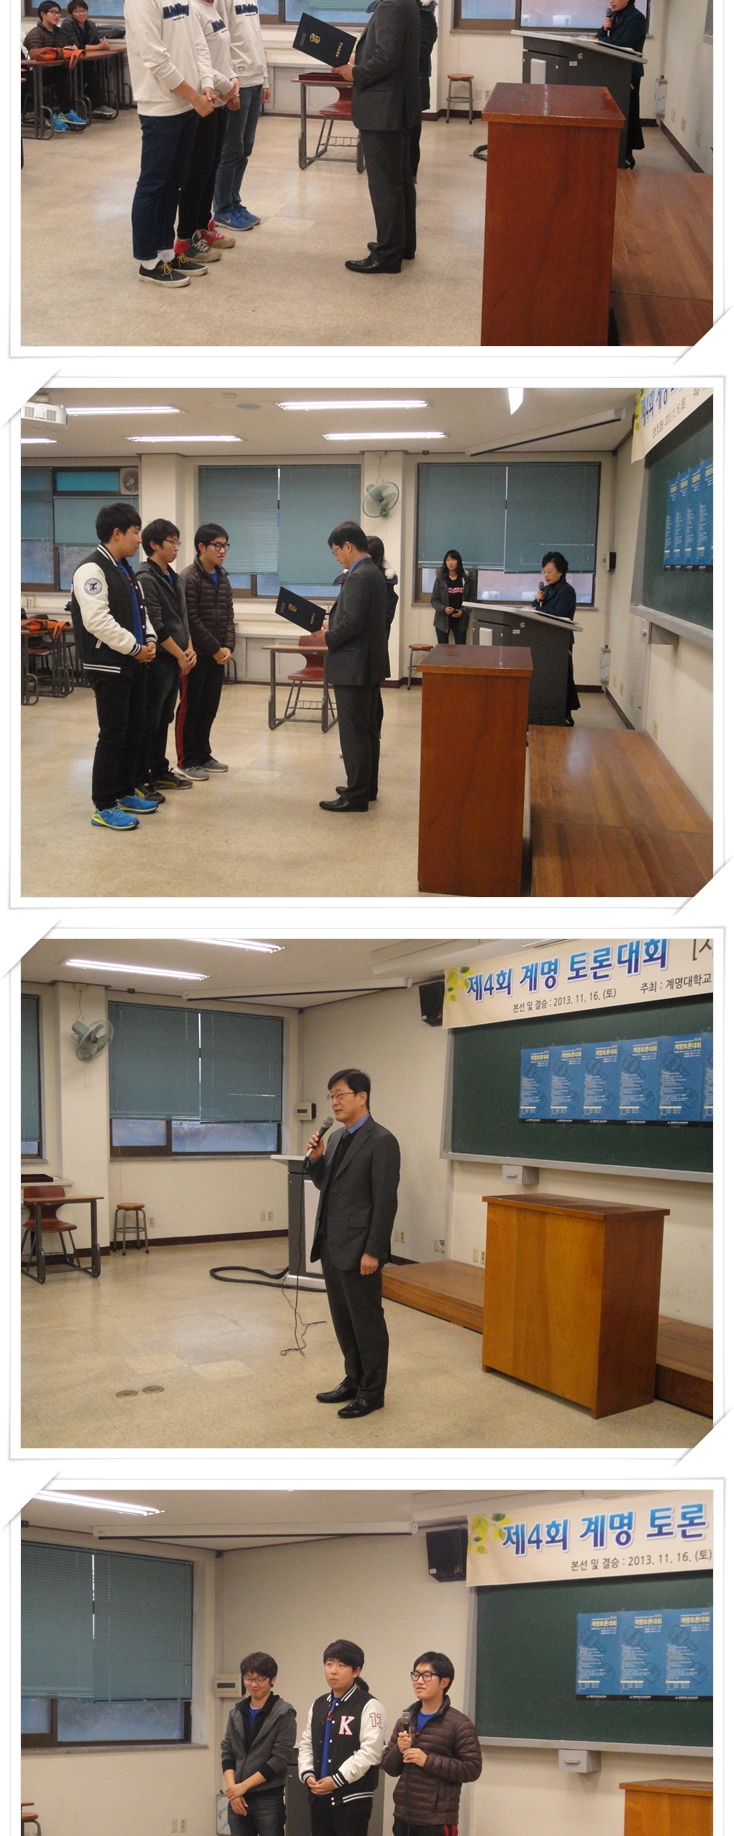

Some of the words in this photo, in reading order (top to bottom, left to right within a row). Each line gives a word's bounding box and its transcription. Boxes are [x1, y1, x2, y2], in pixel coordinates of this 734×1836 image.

[467, 968, 513, 1001] 제4회
[519, 958, 558, 991] 계명
[567, 939, 668, 981] 토론대회
[640, 982, 657, 994] 주최
[666, 973, 712, 990] 계명대학교
[513, 1003, 525, 1013] 본선
[527, 1002, 532, 1010] 및
[535, 999, 547, 1010] 결승
[554, 996, 573, 1006] 2013.
[576, 994, 586, 1003] 11.
[590, 991, 601, 1000] 16.
[602, 988, 616, 999] (토)
[503, 1519, 569, 1555] 제4회
[580, 1511, 633, 1547] 계명
[646, 1503, 706, 1539] 토론
[571, 1560, 587, 1571] 본선
[591, 1559, 599, 1570] 및
[603, 1558, 619, 1569] 결승
[628, 1555, 654, 1566] 2013.
[659, 1554, 672, 1563] 11.
[677, 1552, 691, 1562] 16.
[695, 1549, 712, 1562] (토)
[339, 1715, 355, 1735] K
